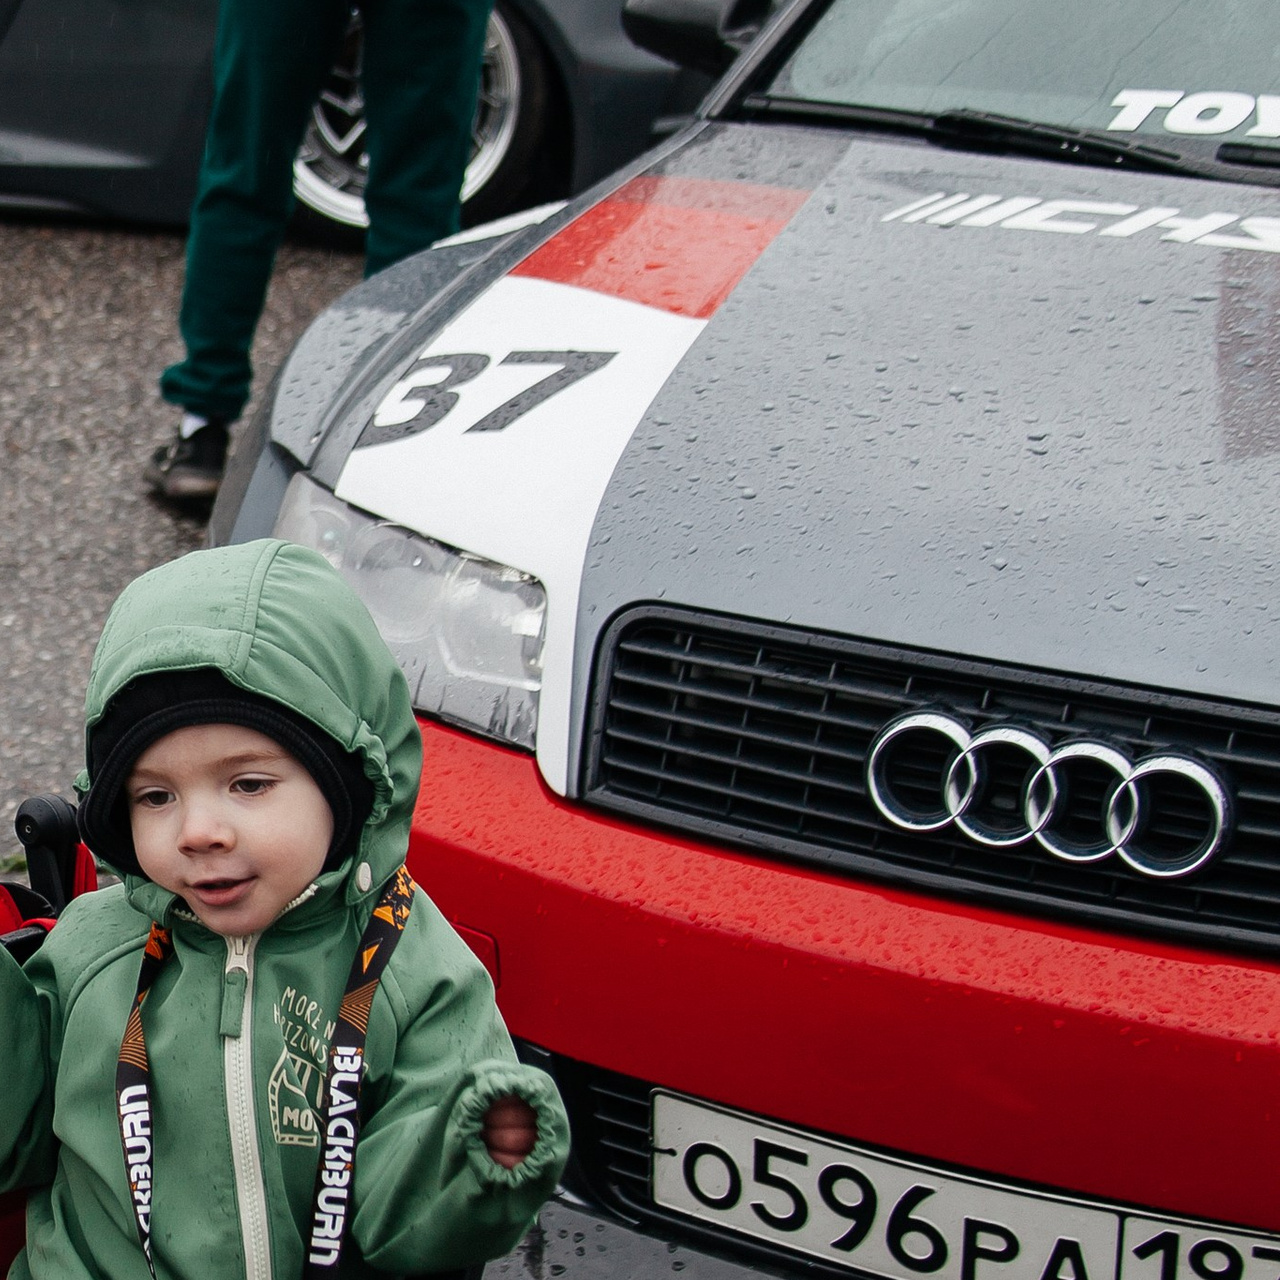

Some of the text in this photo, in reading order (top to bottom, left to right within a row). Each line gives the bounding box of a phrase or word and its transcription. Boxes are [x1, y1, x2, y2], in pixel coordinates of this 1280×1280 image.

[354, 350, 619, 450] 37
[273, 1003, 328, 1064] HRIZONS
[281, 986, 323, 1030] MORE
[282, 1105, 318, 1133] MO
[309, 1046, 362, 1267] BLACKBURN
